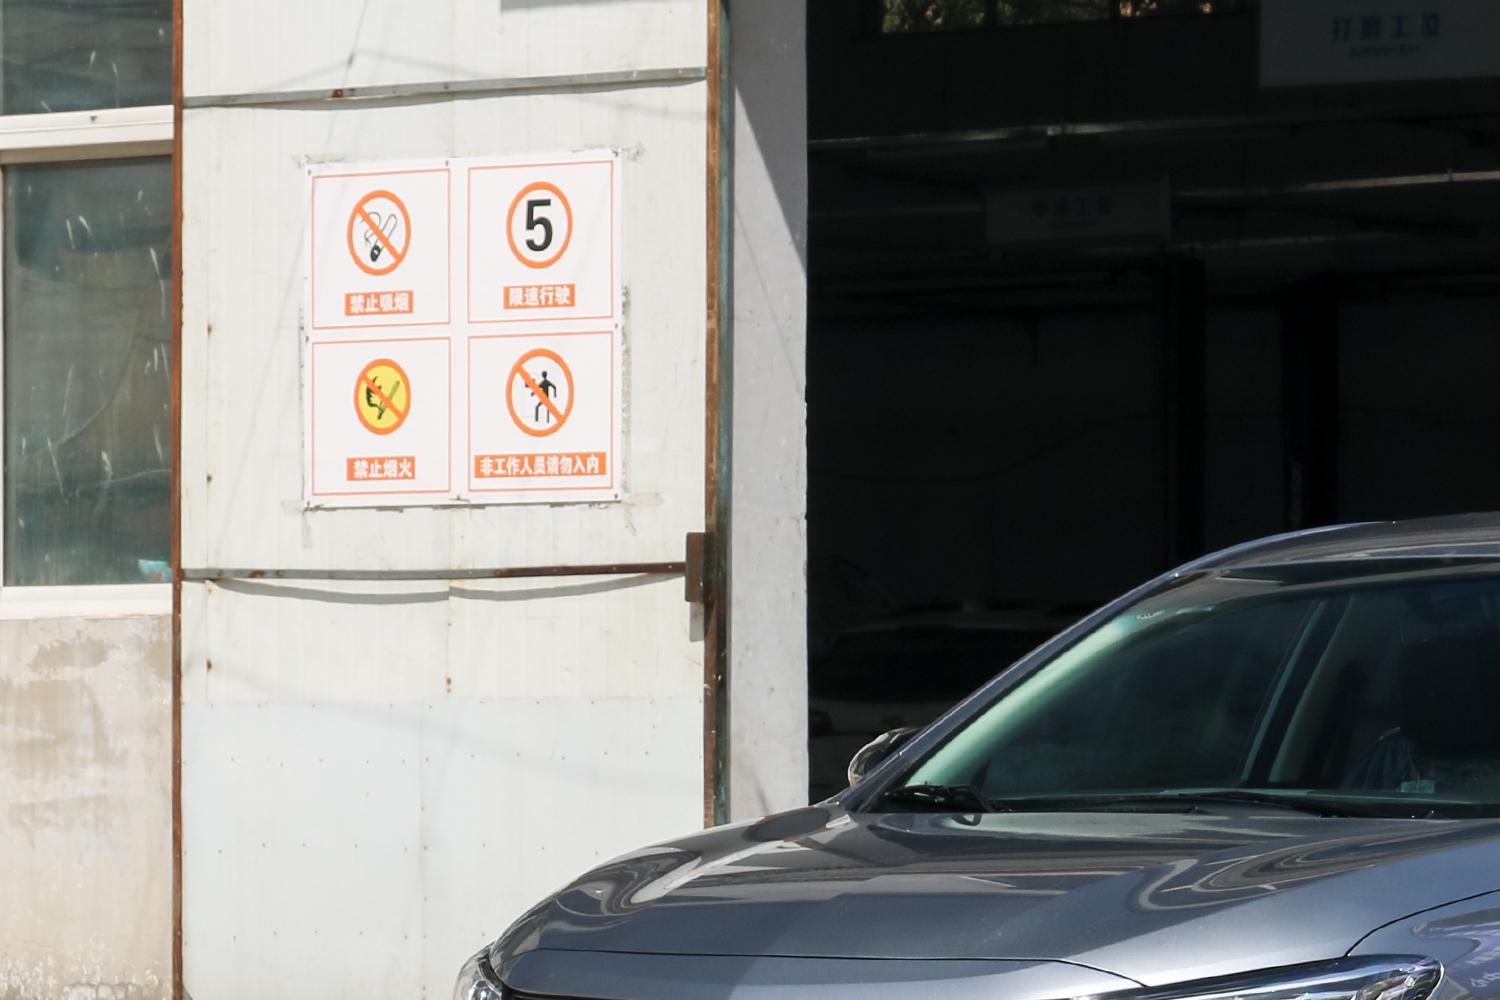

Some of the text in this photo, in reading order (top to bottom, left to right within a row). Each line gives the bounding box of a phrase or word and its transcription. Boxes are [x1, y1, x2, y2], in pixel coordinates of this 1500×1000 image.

[525, 199, 554, 252] 5
[349, 291, 410, 314] 禁止吸烟
[508, 284, 571, 306] 限速行驶
[353, 457, 413, 479] 禁止烟火
[479, 453, 601, 476] 非工作人员请勿入内
